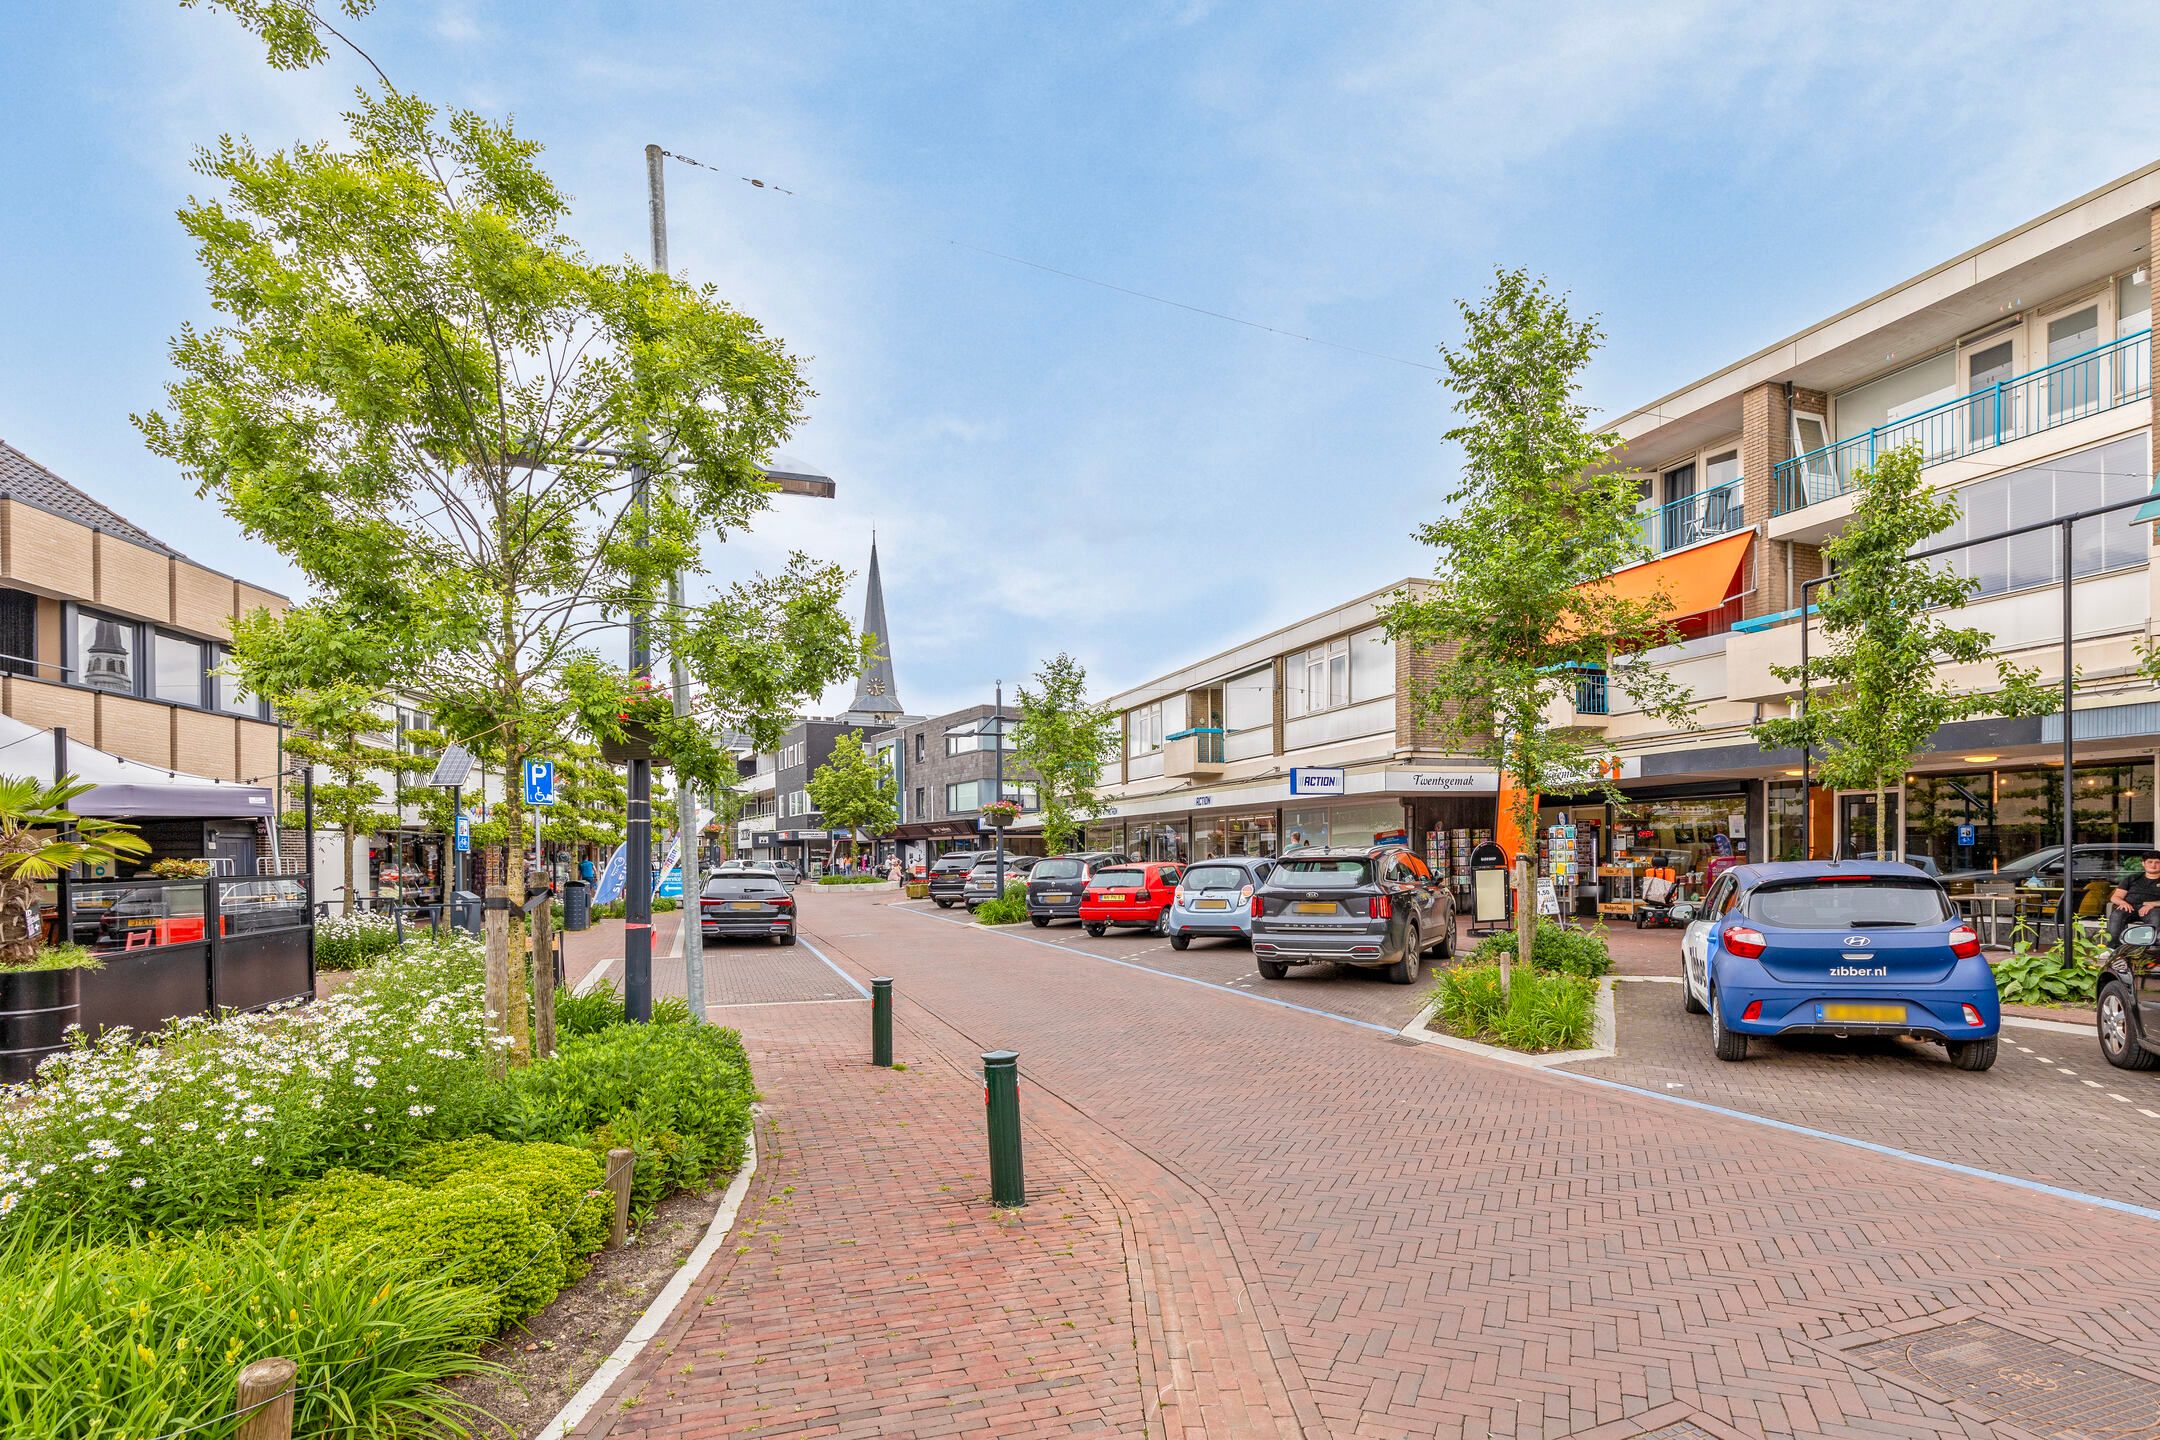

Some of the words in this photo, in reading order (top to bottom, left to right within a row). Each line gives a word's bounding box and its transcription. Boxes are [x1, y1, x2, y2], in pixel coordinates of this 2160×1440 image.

[531, 763, 547, 786] P
[1304, 776, 1335, 787] ACTION
[1413, 774, 1474, 790] Twentsgemak
[1196, 796, 1211, 806] ACTION
[1638, 830, 1654, 838] OPEN
[1829, 965, 1887, 977] zibber.nl
